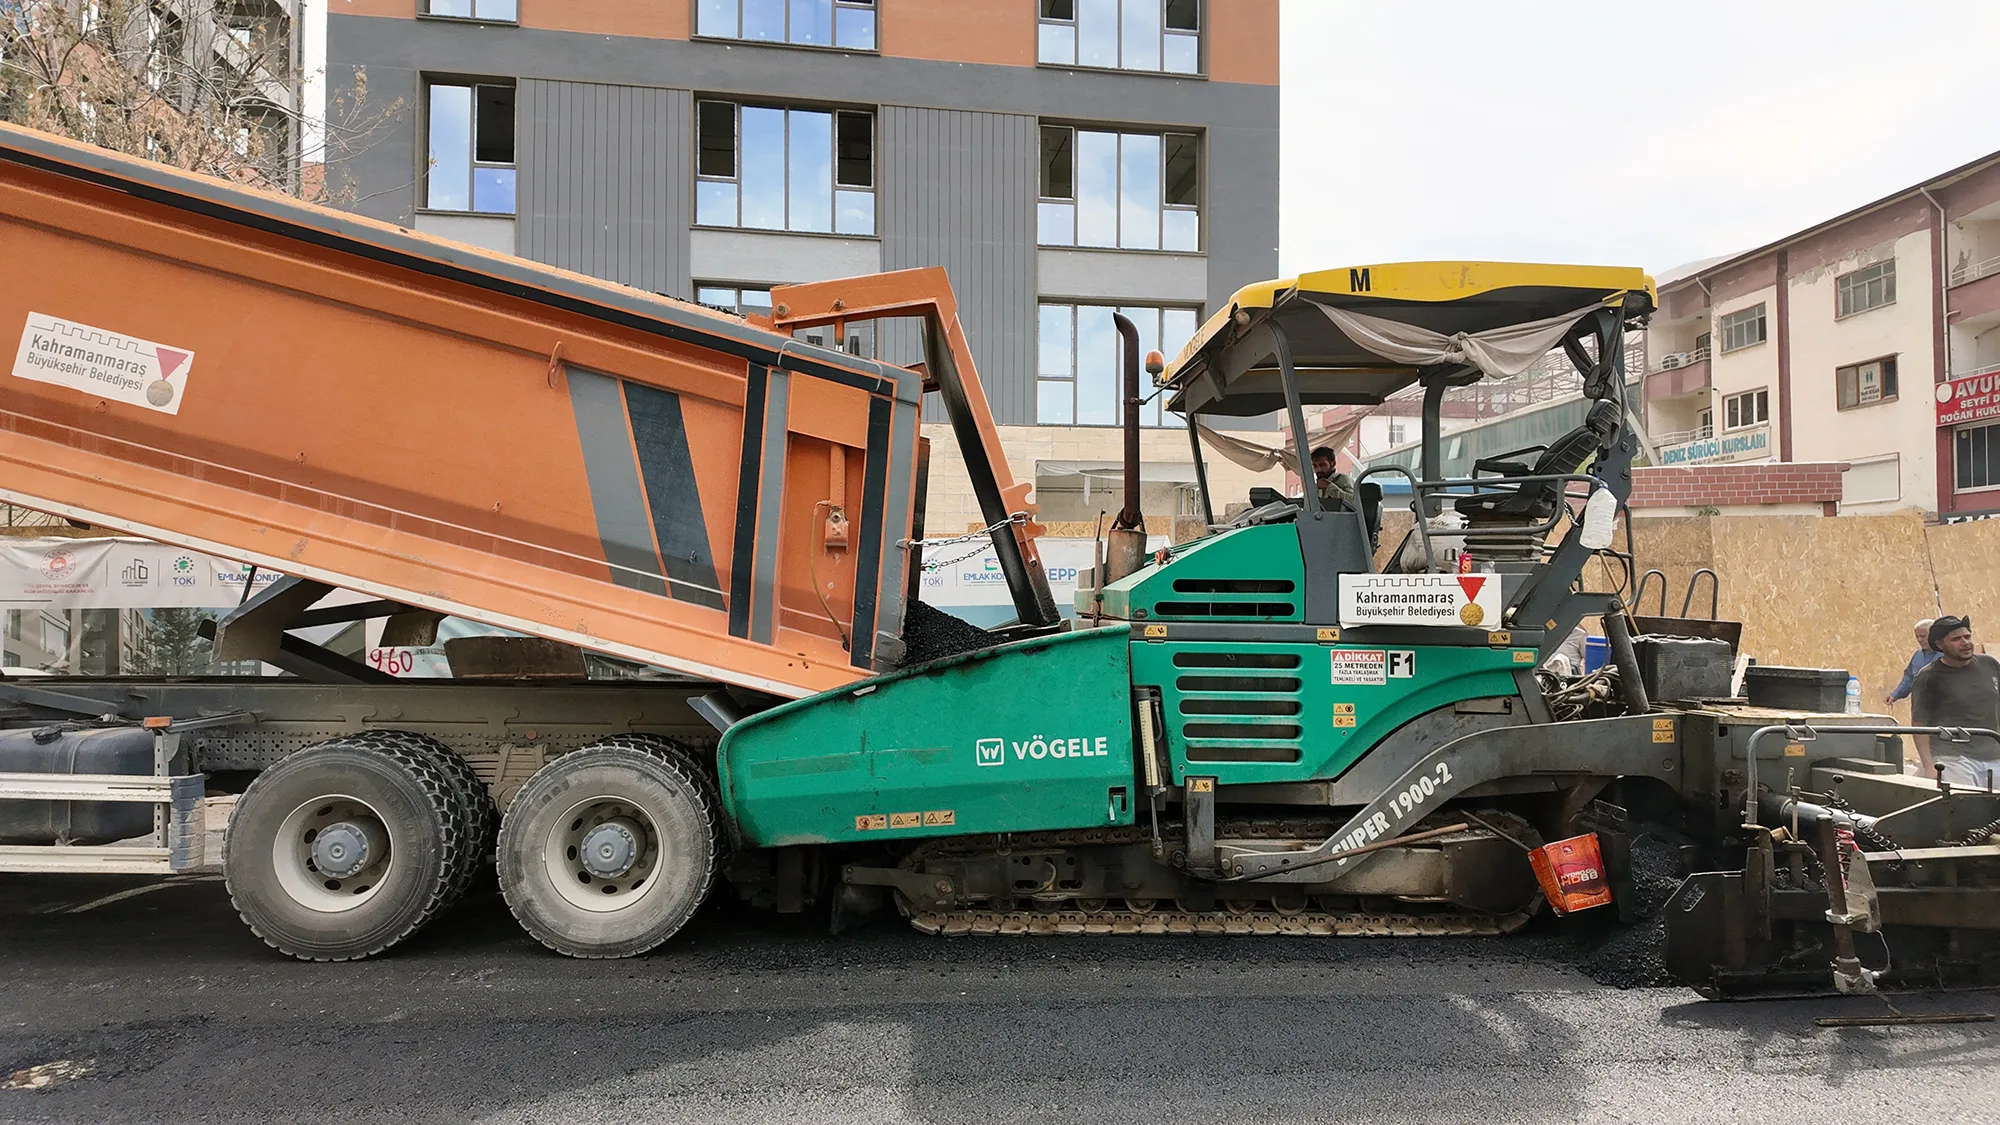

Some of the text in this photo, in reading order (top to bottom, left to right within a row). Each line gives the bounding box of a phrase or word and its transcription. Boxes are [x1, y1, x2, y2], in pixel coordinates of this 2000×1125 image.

[1350, 268, 1371, 292] M
[31, 333, 148, 377] Kahramanmaraş
[26, 351, 145, 391] Büyükşehir Belediyesi
[1960, 394, 1990, 409] SEYFİ
[1940, 410, 1974, 423] DOĞAN
[1663, 445, 1686, 465] DENİZ
[1687, 437, 1720, 460] SÜRÜCÜ
[1721, 433, 1766, 454] KURSLARI
[217, 572, 282, 583] EMLAK ONUT
[964, 572, 990, 581] EMLAK
[1048, 567, 1077, 581] EPP
[1356, 591, 1454, 605] Kahramanmaraş
[1356, 605, 1455, 618] Büyükşehir Belediyesi
[370, 648, 413, 674] 960
[1344, 651, 1383, 661] DİKKAT
[1389, 652, 1414, 676] F1
[1012, 734, 1108, 760] VÖGELE
[1331, 762, 1453, 867] SUPER 1900-2
